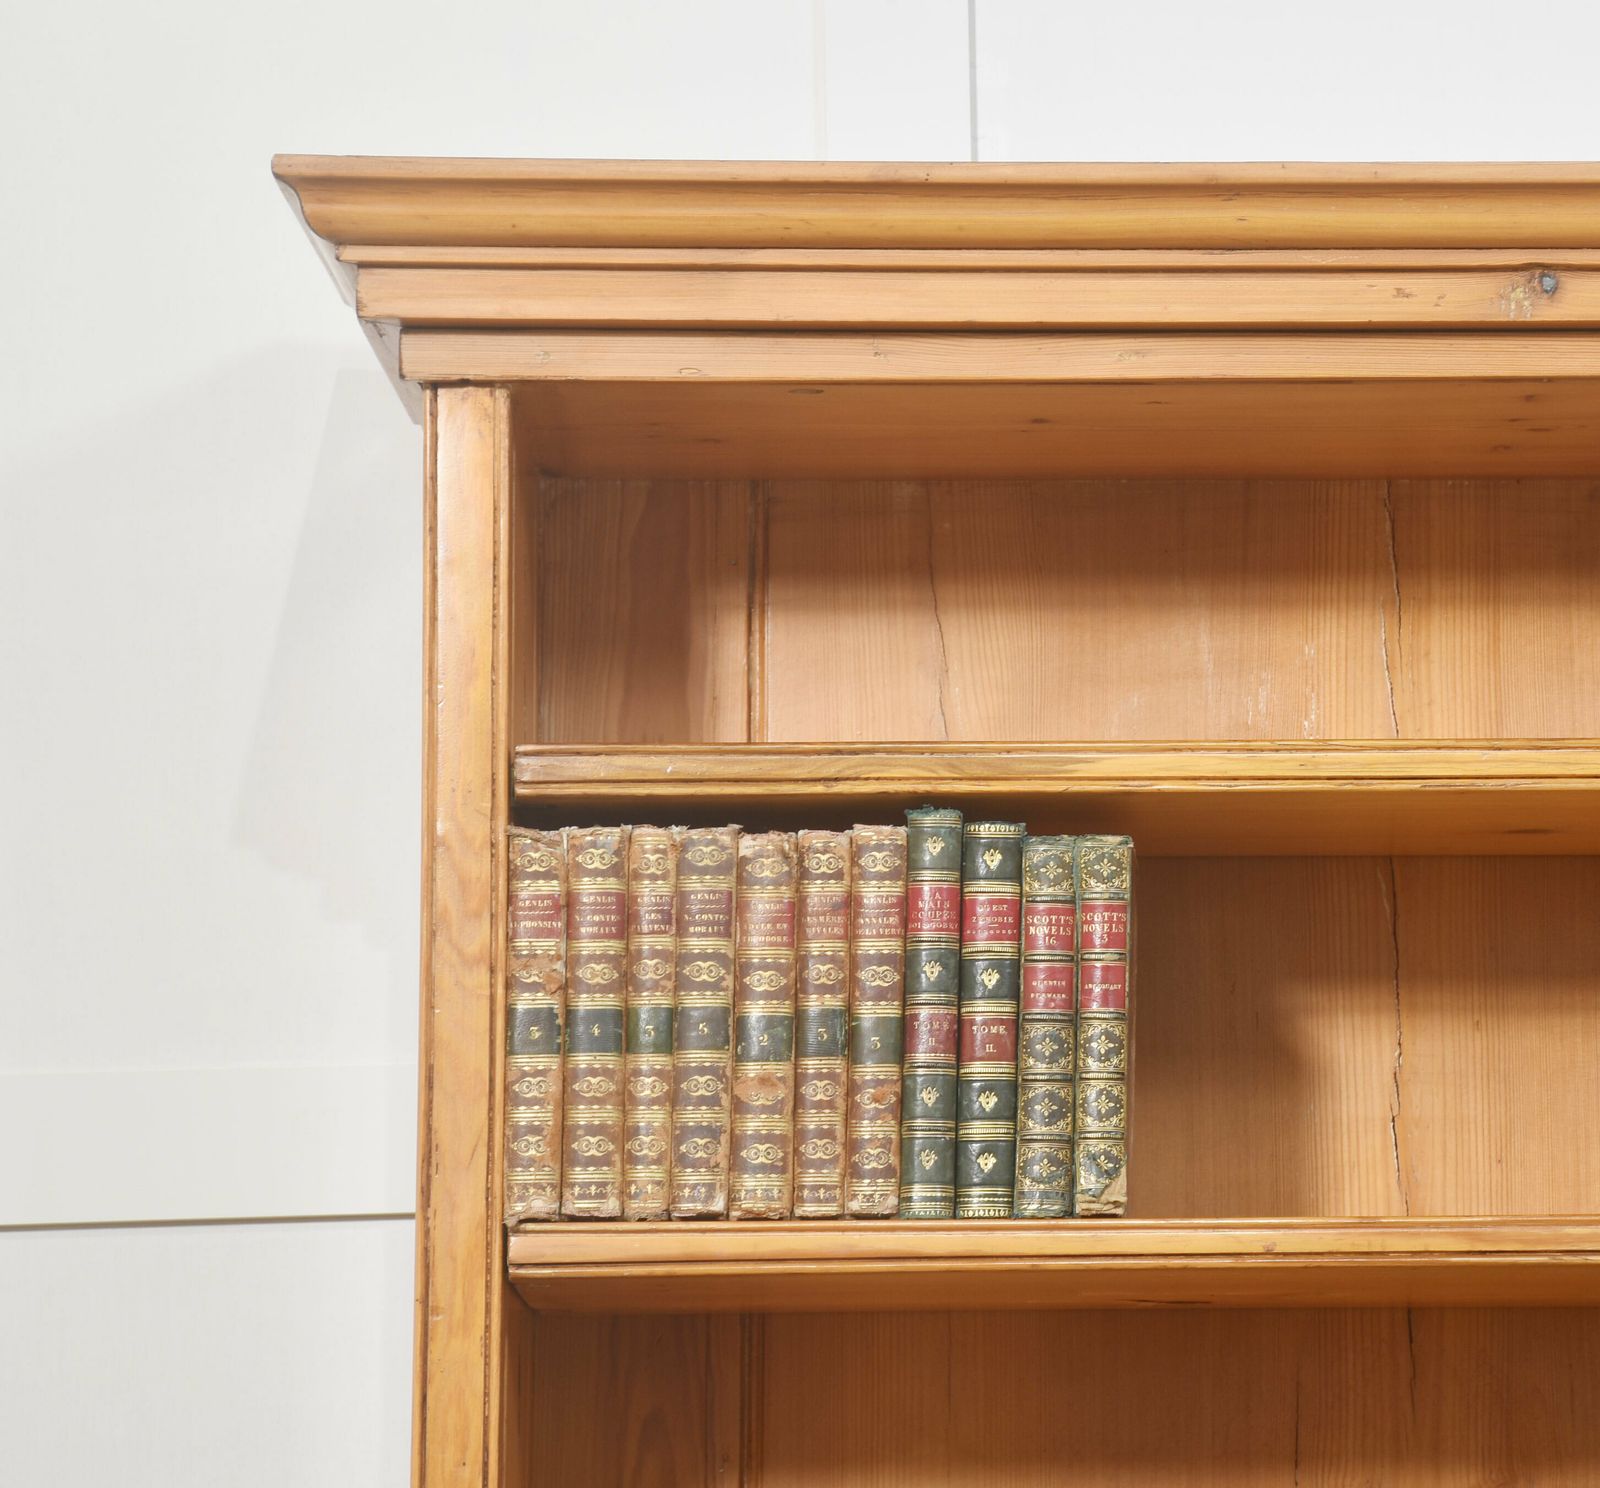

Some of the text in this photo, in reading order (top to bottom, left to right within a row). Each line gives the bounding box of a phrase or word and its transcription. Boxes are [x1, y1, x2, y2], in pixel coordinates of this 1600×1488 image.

[582, 895, 616, 903] GENLIS
[1026, 914, 1074, 924] SCOTT'S
[1081, 912, 1127, 922] SCOTT'S
[1029, 926, 1072, 936] NOVELS
[1082, 923, 1125, 933] NOVELS
[1045, 936, 1057, 945] 16
[1101, 933, 1109, 944] 3
[645, 1025, 655, 1037] 3
[698, 1022, 708, 1035] 5
[758, 1033, 768, 1046] 2
[817, 1028, 828, 1041] 3
[870, 1036, 881, 1049] 3
